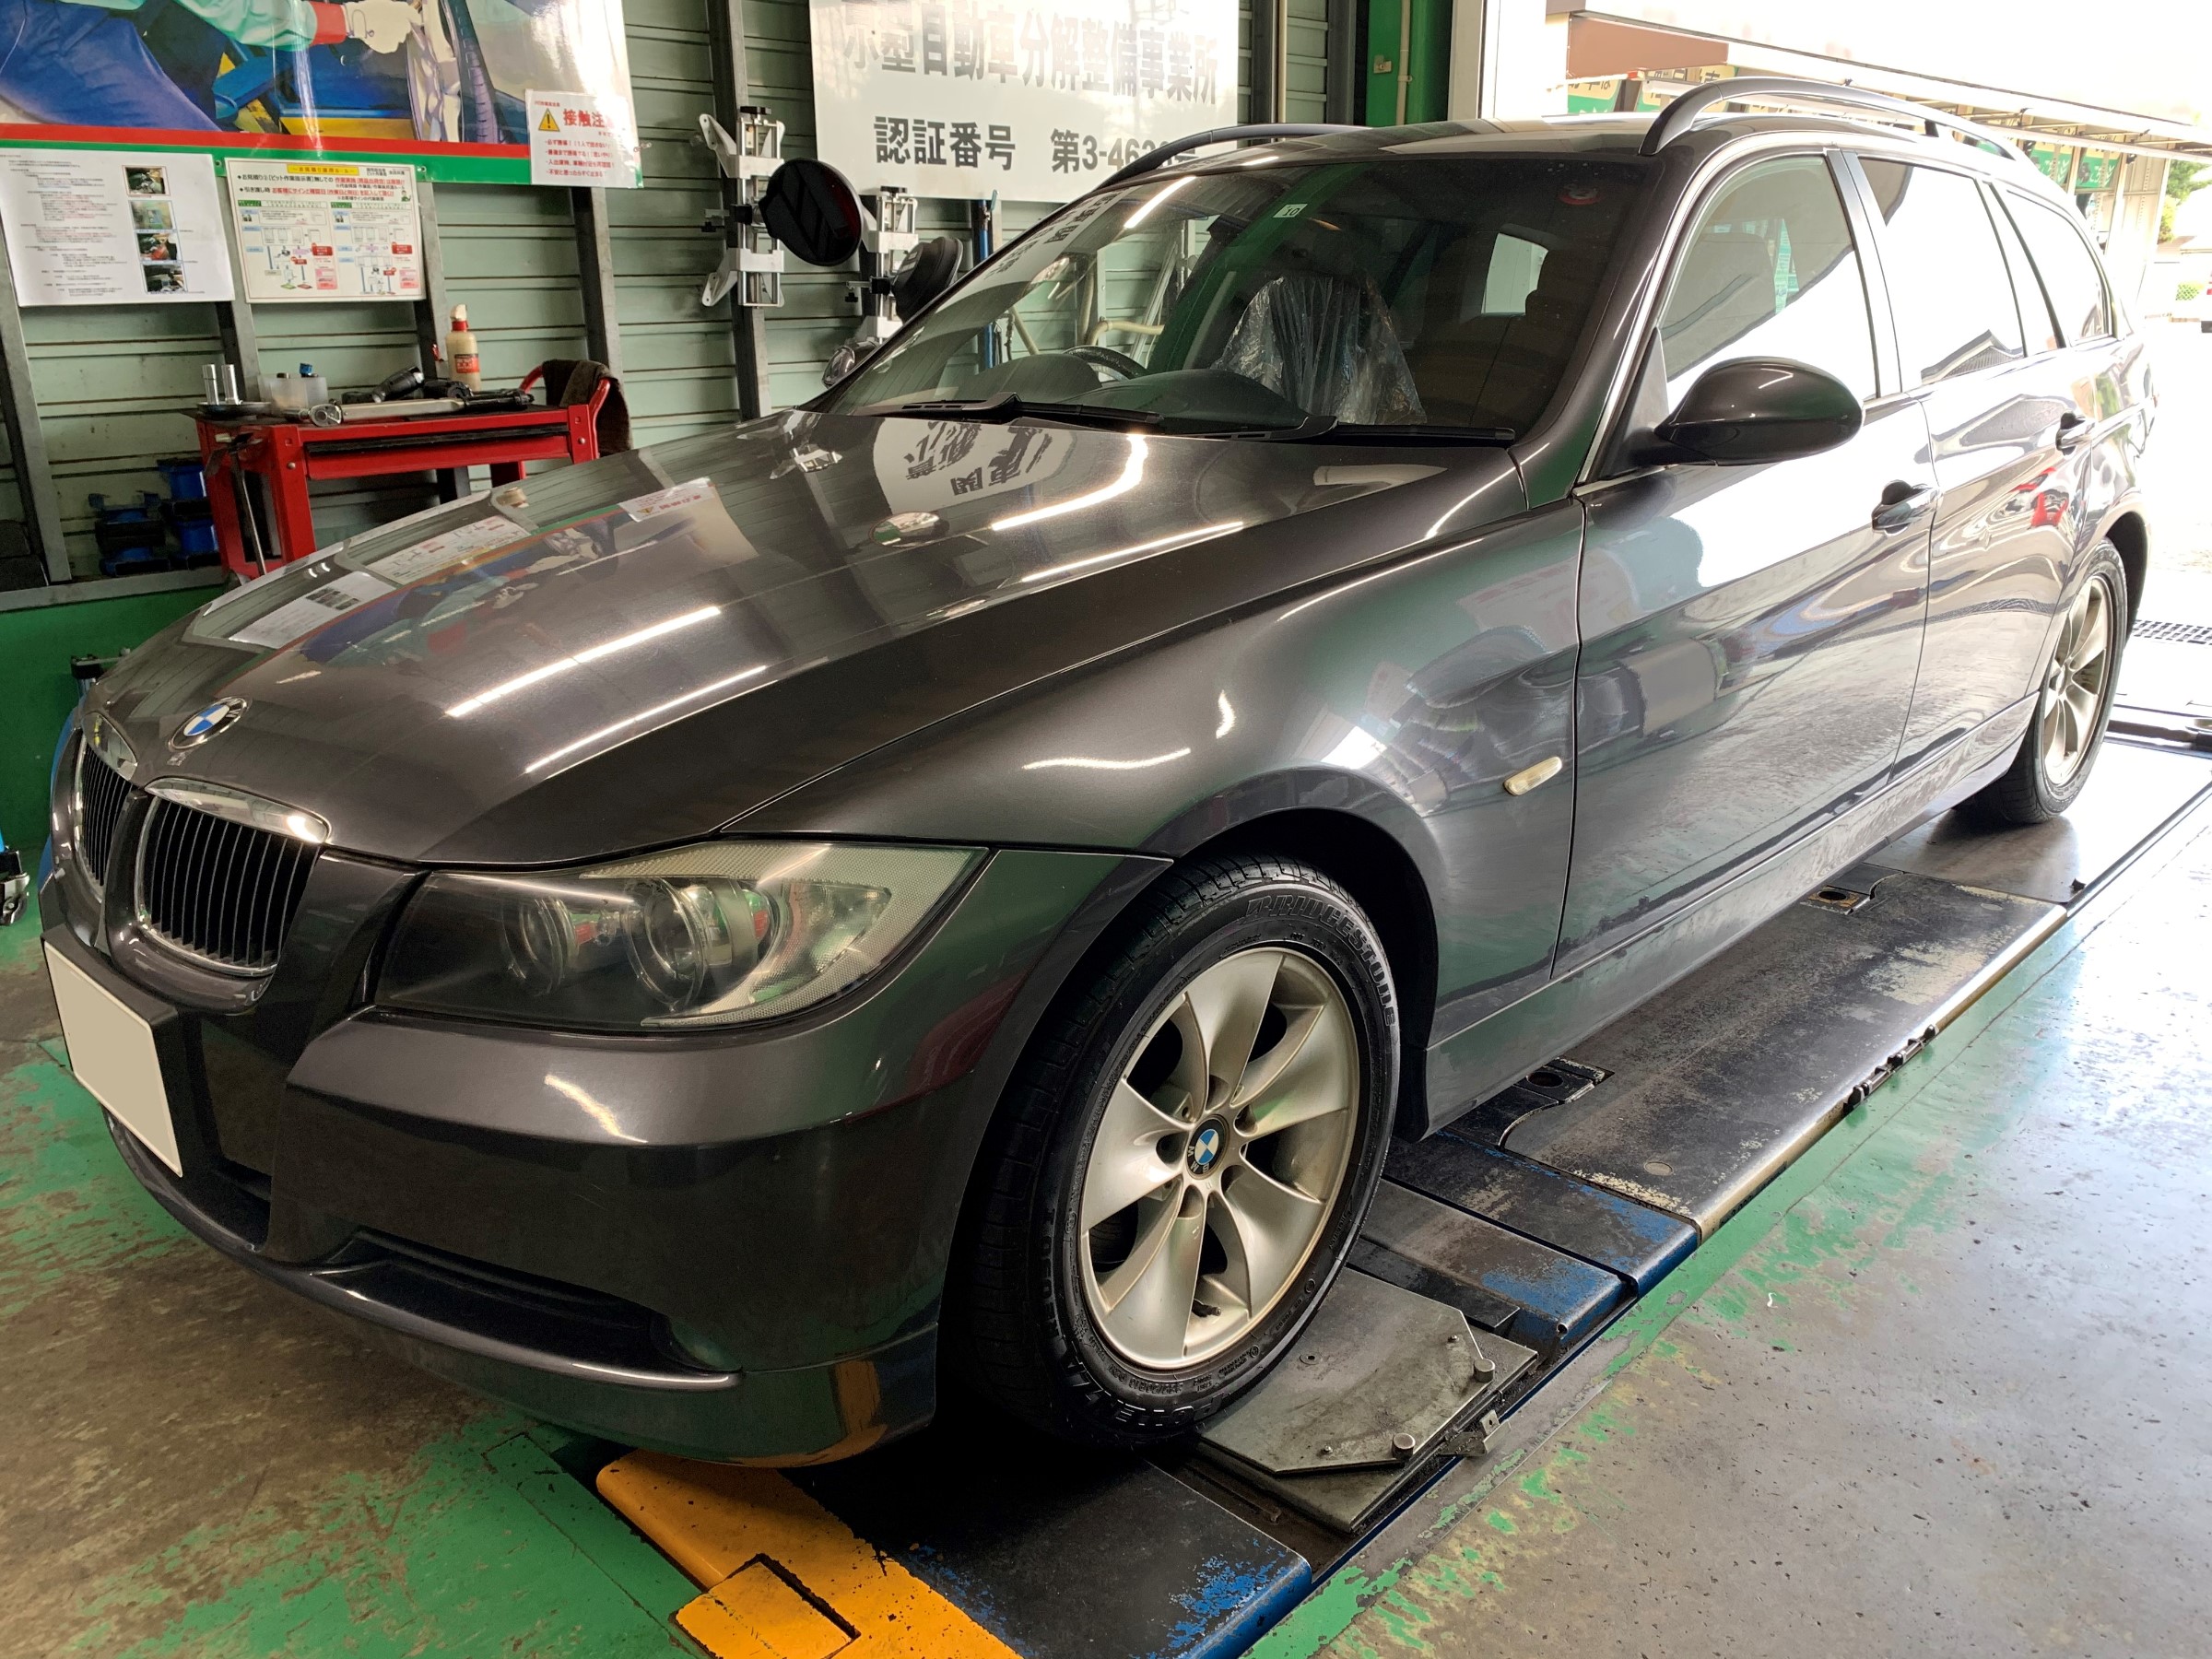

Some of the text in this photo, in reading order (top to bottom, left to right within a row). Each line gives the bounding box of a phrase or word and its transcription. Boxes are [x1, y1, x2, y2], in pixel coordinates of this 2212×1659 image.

[873, 115, 1017, 172] 認証番号
[1245, 893, 1396, 1027] BRIDGESTONE
[1186, 1145, 1210, 1174] BMW
